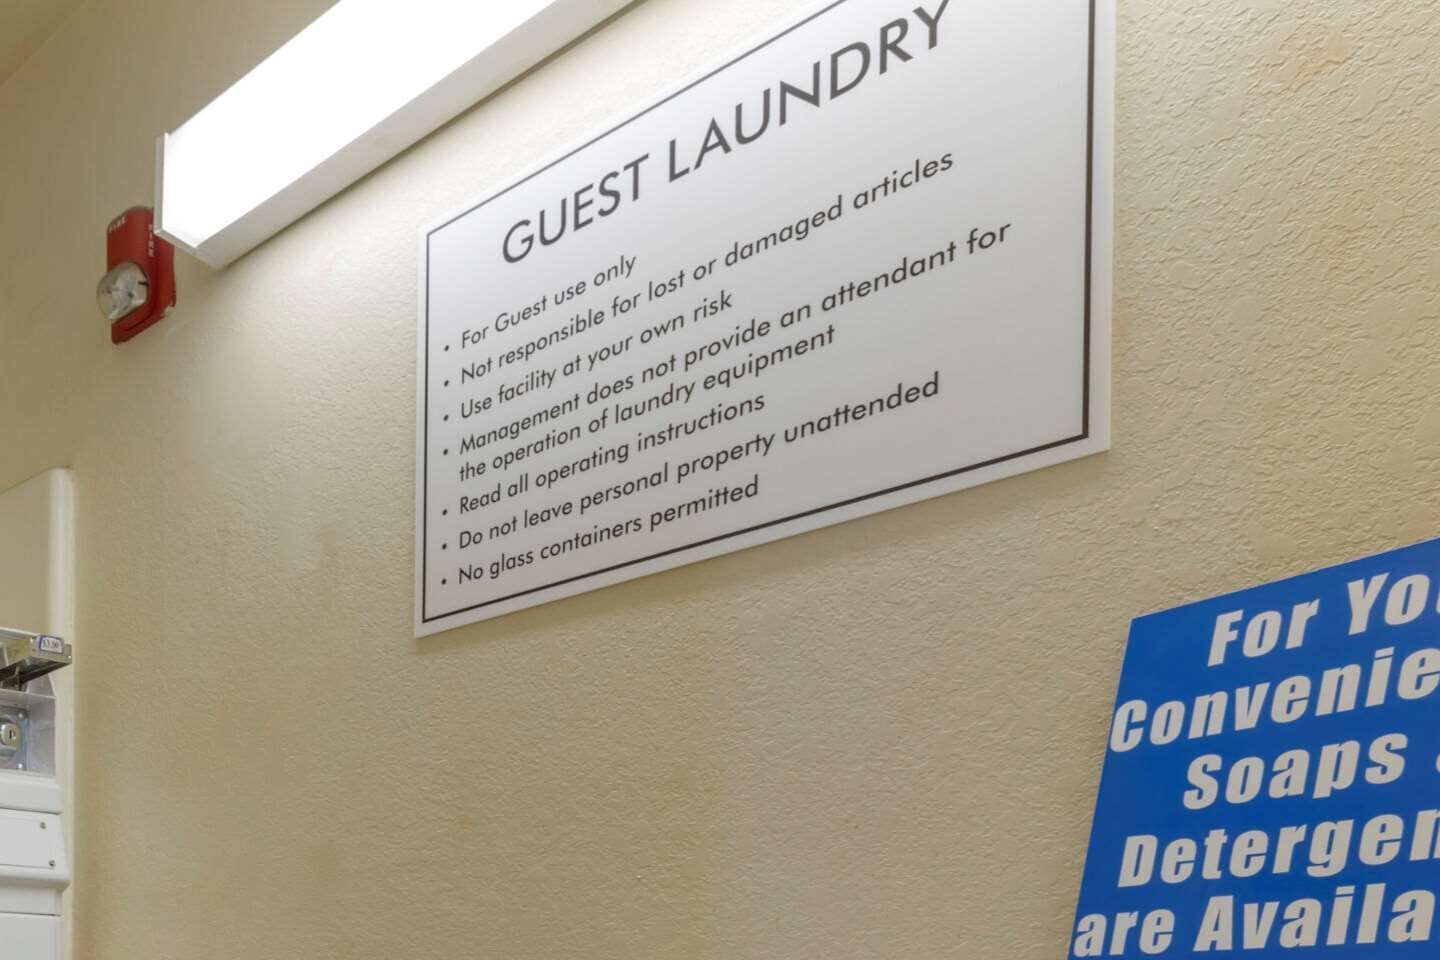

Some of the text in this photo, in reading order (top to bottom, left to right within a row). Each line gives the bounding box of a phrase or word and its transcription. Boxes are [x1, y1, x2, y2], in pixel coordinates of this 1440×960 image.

[503, 0, 949, 263] GUEST LAUNDRY
[462, 153, 953, 384] Not responsible for lost or damaged articles
[462, 255, 636, 349] For Guest use only
[460, 224, 1011, 455] Management does not provide an attendant for
[461, 290, 732, 418] Use facility at your own risk
[460, 325, 835, 481] the operation of laundry equipment
[460, 395, 764, 514] Read all operating instructions
[460, 371, 939, 549] Do not leave personal property unattended
[459, 474, 758, 584] No glass containers permitted
[1208, 573, 1440, 666] For Yo
[1184, 734, 1407, 809] Soaps
[1074, 883, 1435, 957] are Availa
